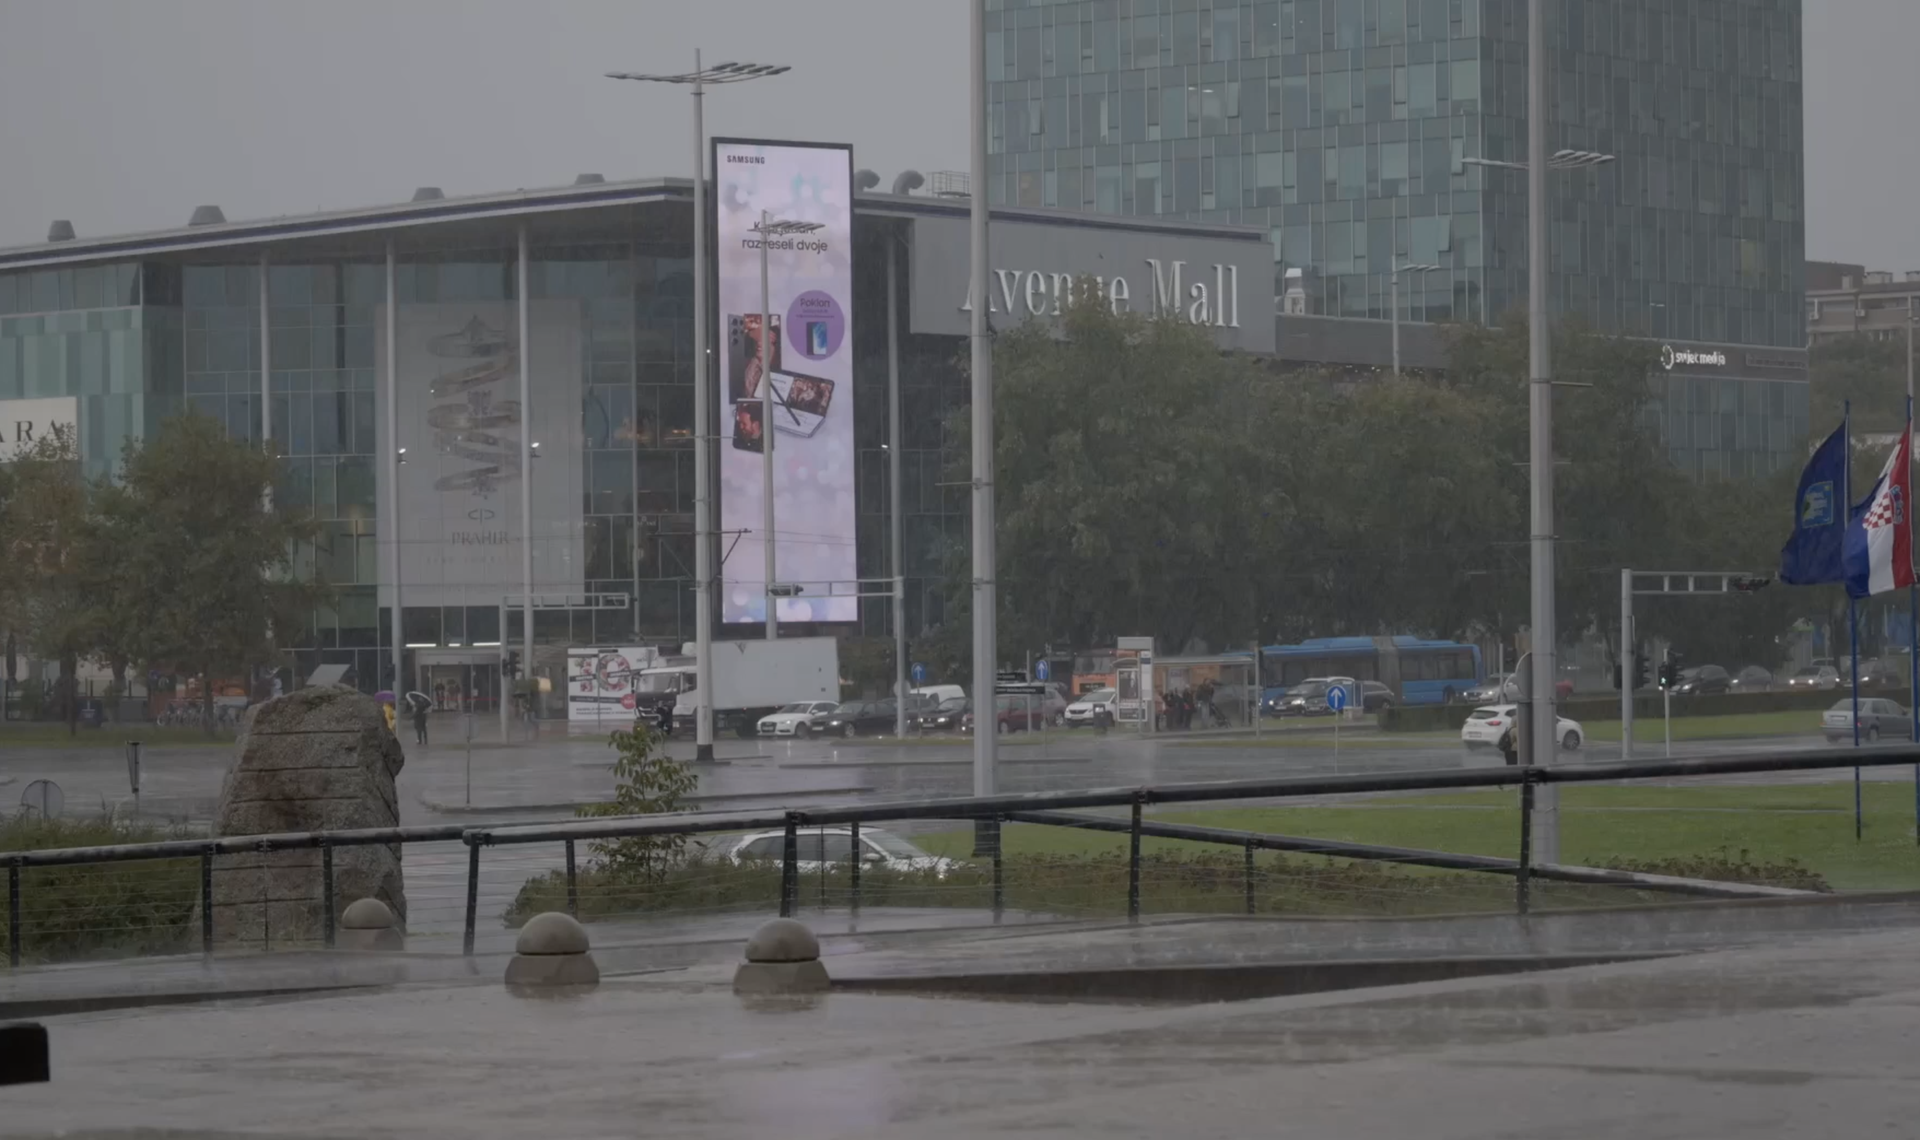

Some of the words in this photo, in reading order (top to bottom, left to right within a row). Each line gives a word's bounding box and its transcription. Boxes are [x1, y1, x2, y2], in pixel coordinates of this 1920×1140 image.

[727, 155, 765, 165] SAMSUNG
[742, 238, 794, 250] razeseli
[796, 239, 828, 254] dvoje
[1145, 258, 1241, 328] Mall
[800, 298, 831, 308] Poklon
[0, 419, 62, 443] RA
[451, 530, 510, 546] PRAHIR
